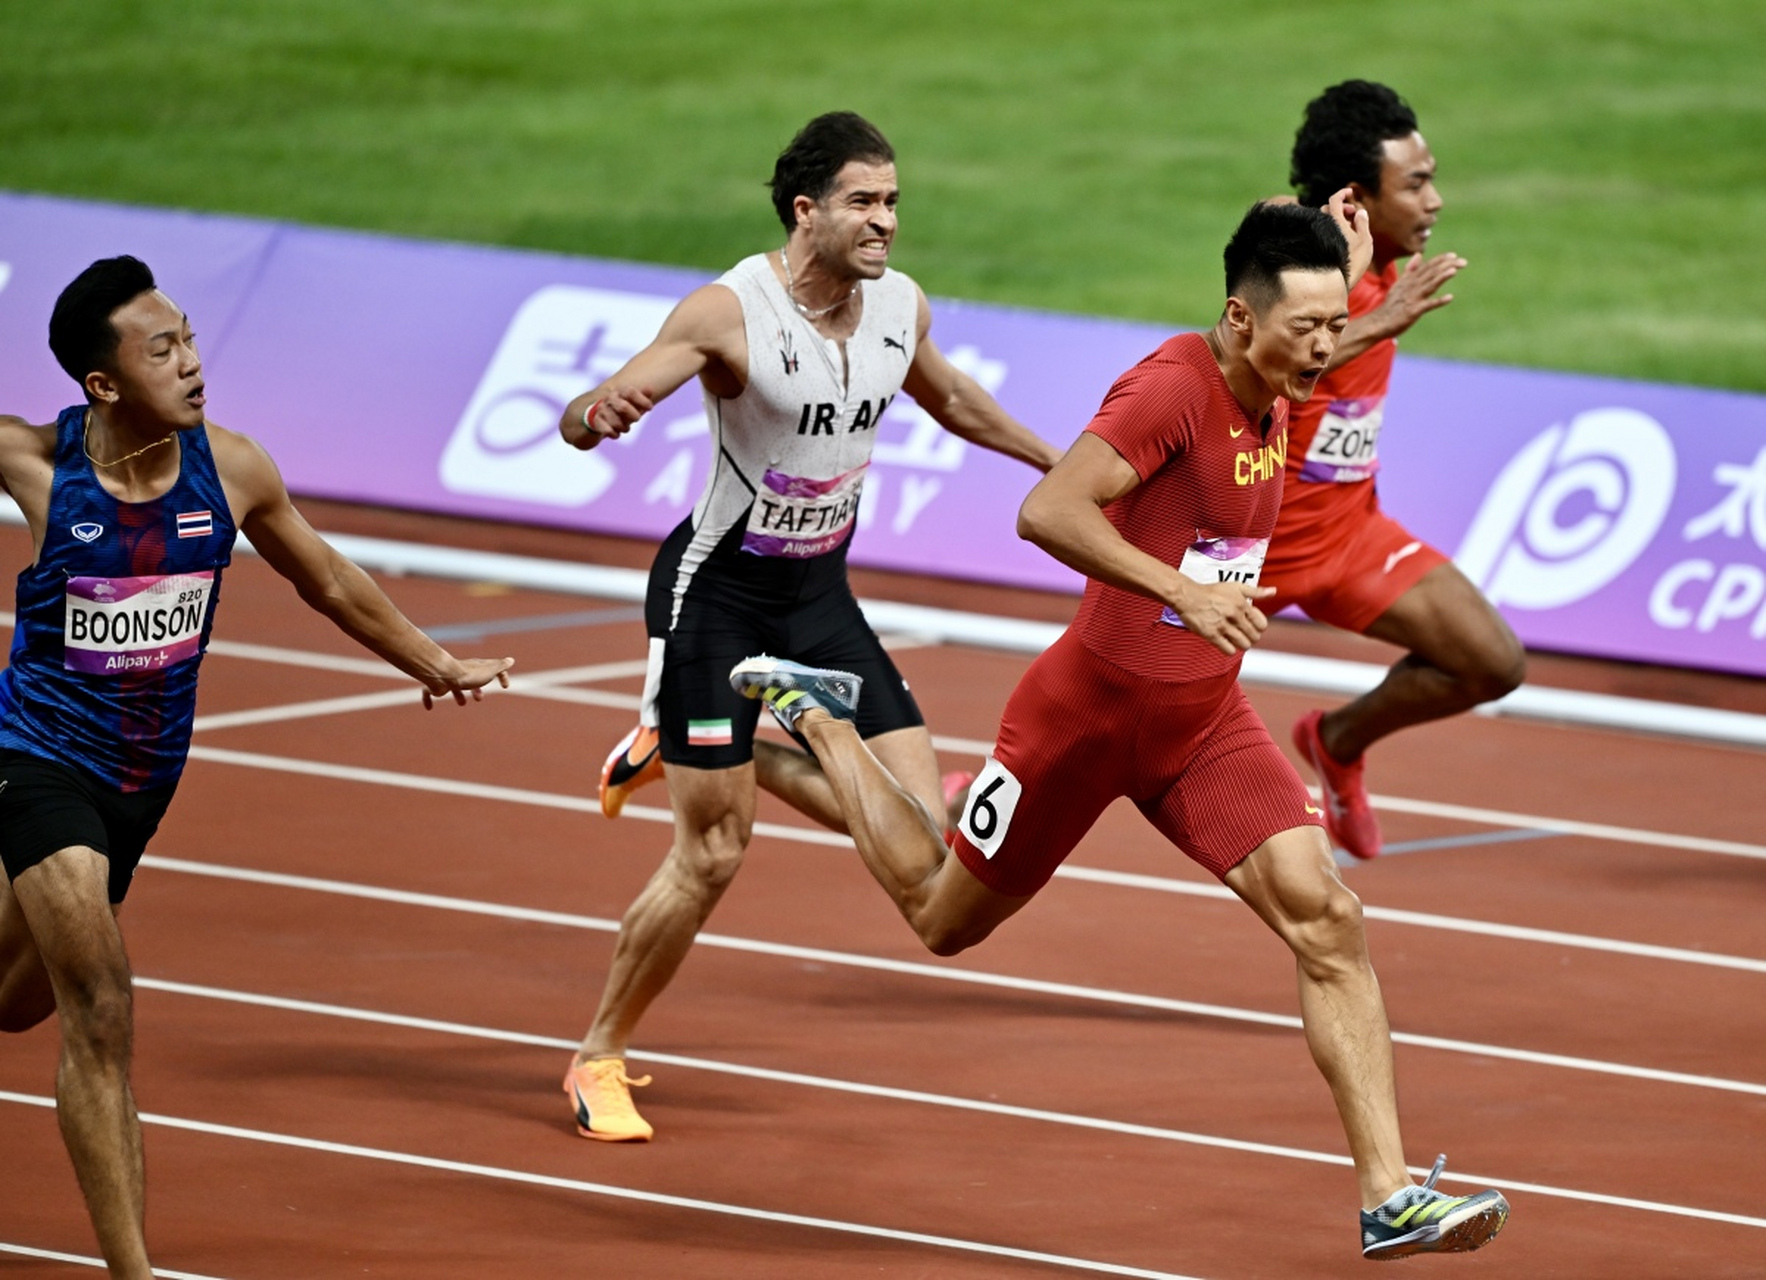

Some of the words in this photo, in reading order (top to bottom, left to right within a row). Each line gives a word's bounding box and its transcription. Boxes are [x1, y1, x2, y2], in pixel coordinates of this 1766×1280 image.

[1318, 427, 1382, 458] ZOH
[178, 588, 203, 603] 820
[70, 601, 203, 645] BOONSON
[969, 776, 1006, 840] 6
